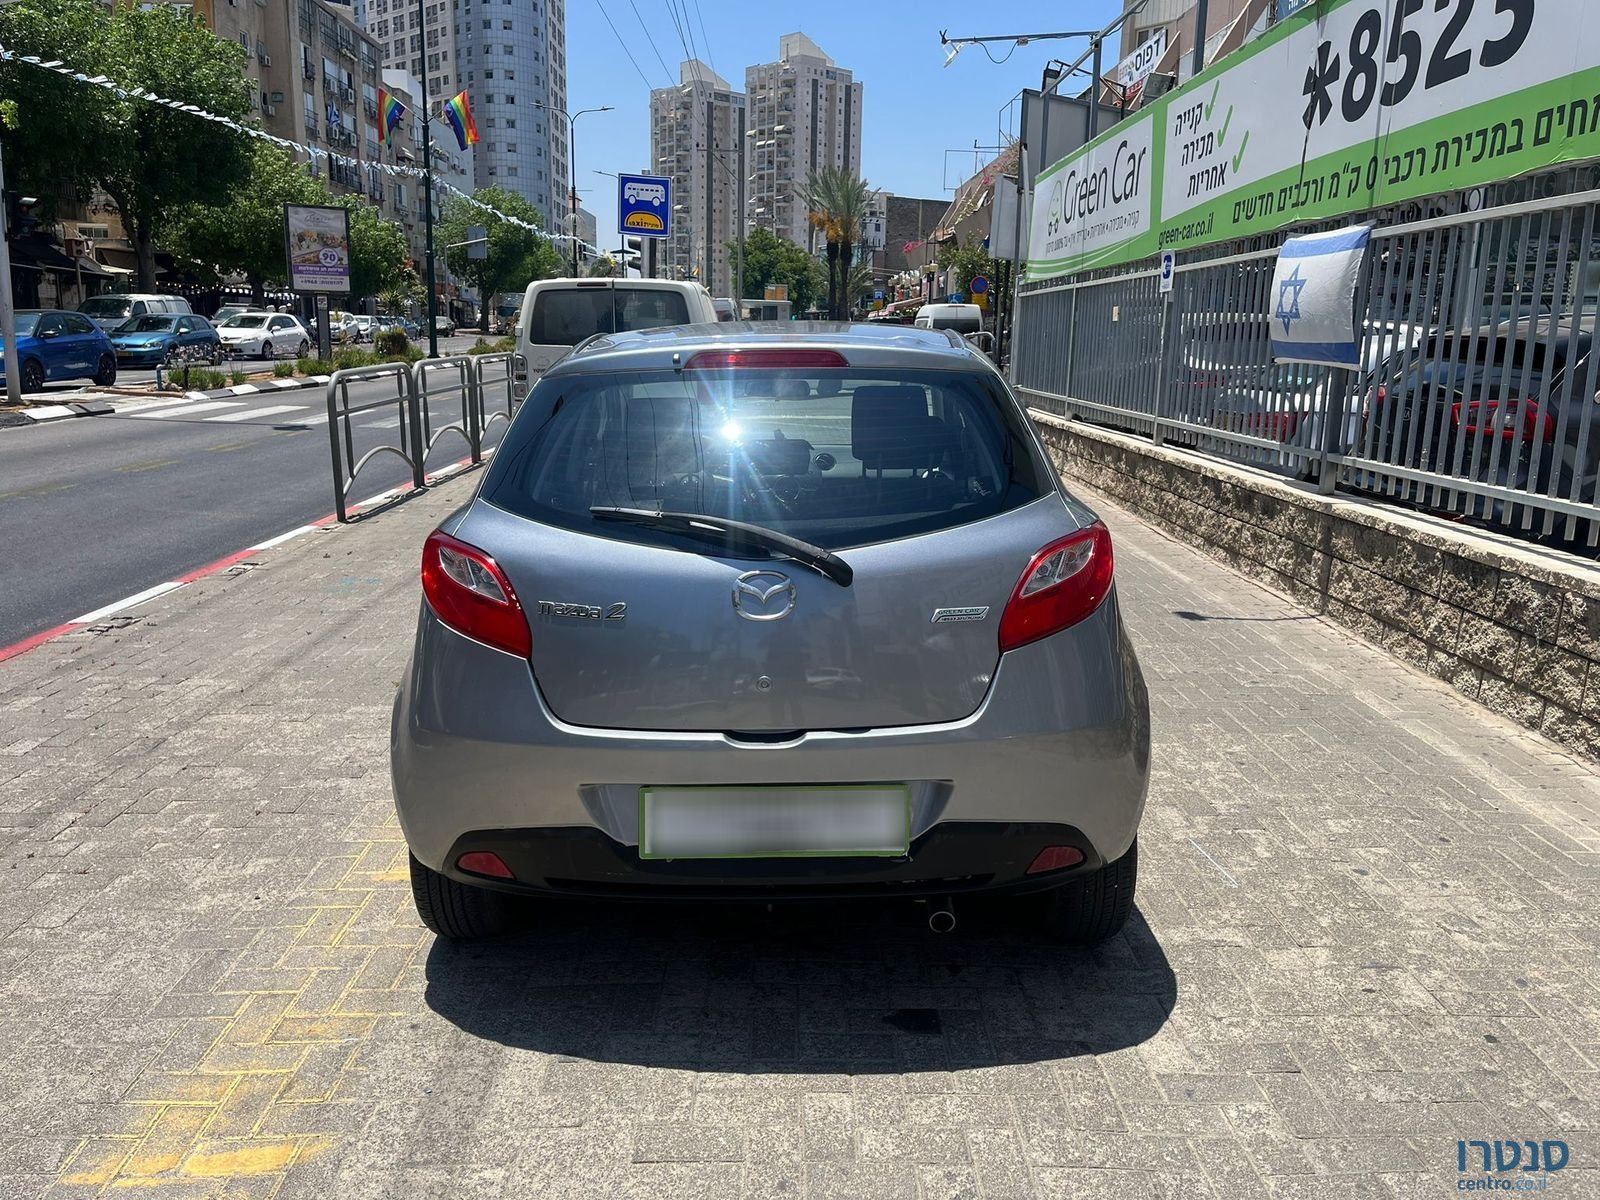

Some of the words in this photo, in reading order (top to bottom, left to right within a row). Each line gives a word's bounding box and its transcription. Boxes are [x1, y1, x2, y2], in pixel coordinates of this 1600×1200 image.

[1135, 37, 1161, 72] דפוס
[1174, 102, 1203, 136] קנייה
[1181, 131, 1214, 166] מכירה
[1431, 118, 1524, 174] במכירת
[1064, 170, 1108, 224] Green
[1112, 140, 1147, 204] Car
[1187, 161, 1228, 198] אחריות
[1384, 147, 1426, 186] רכבי
[1232, 191, 1274, 224] חדשים
[1277, 176, 1325, 213] ורכבים
[1158, 211, 1214, 250] green-car.co.il
[322, 253, 336, 262] 90
[604, 602, 627, 621] 2
